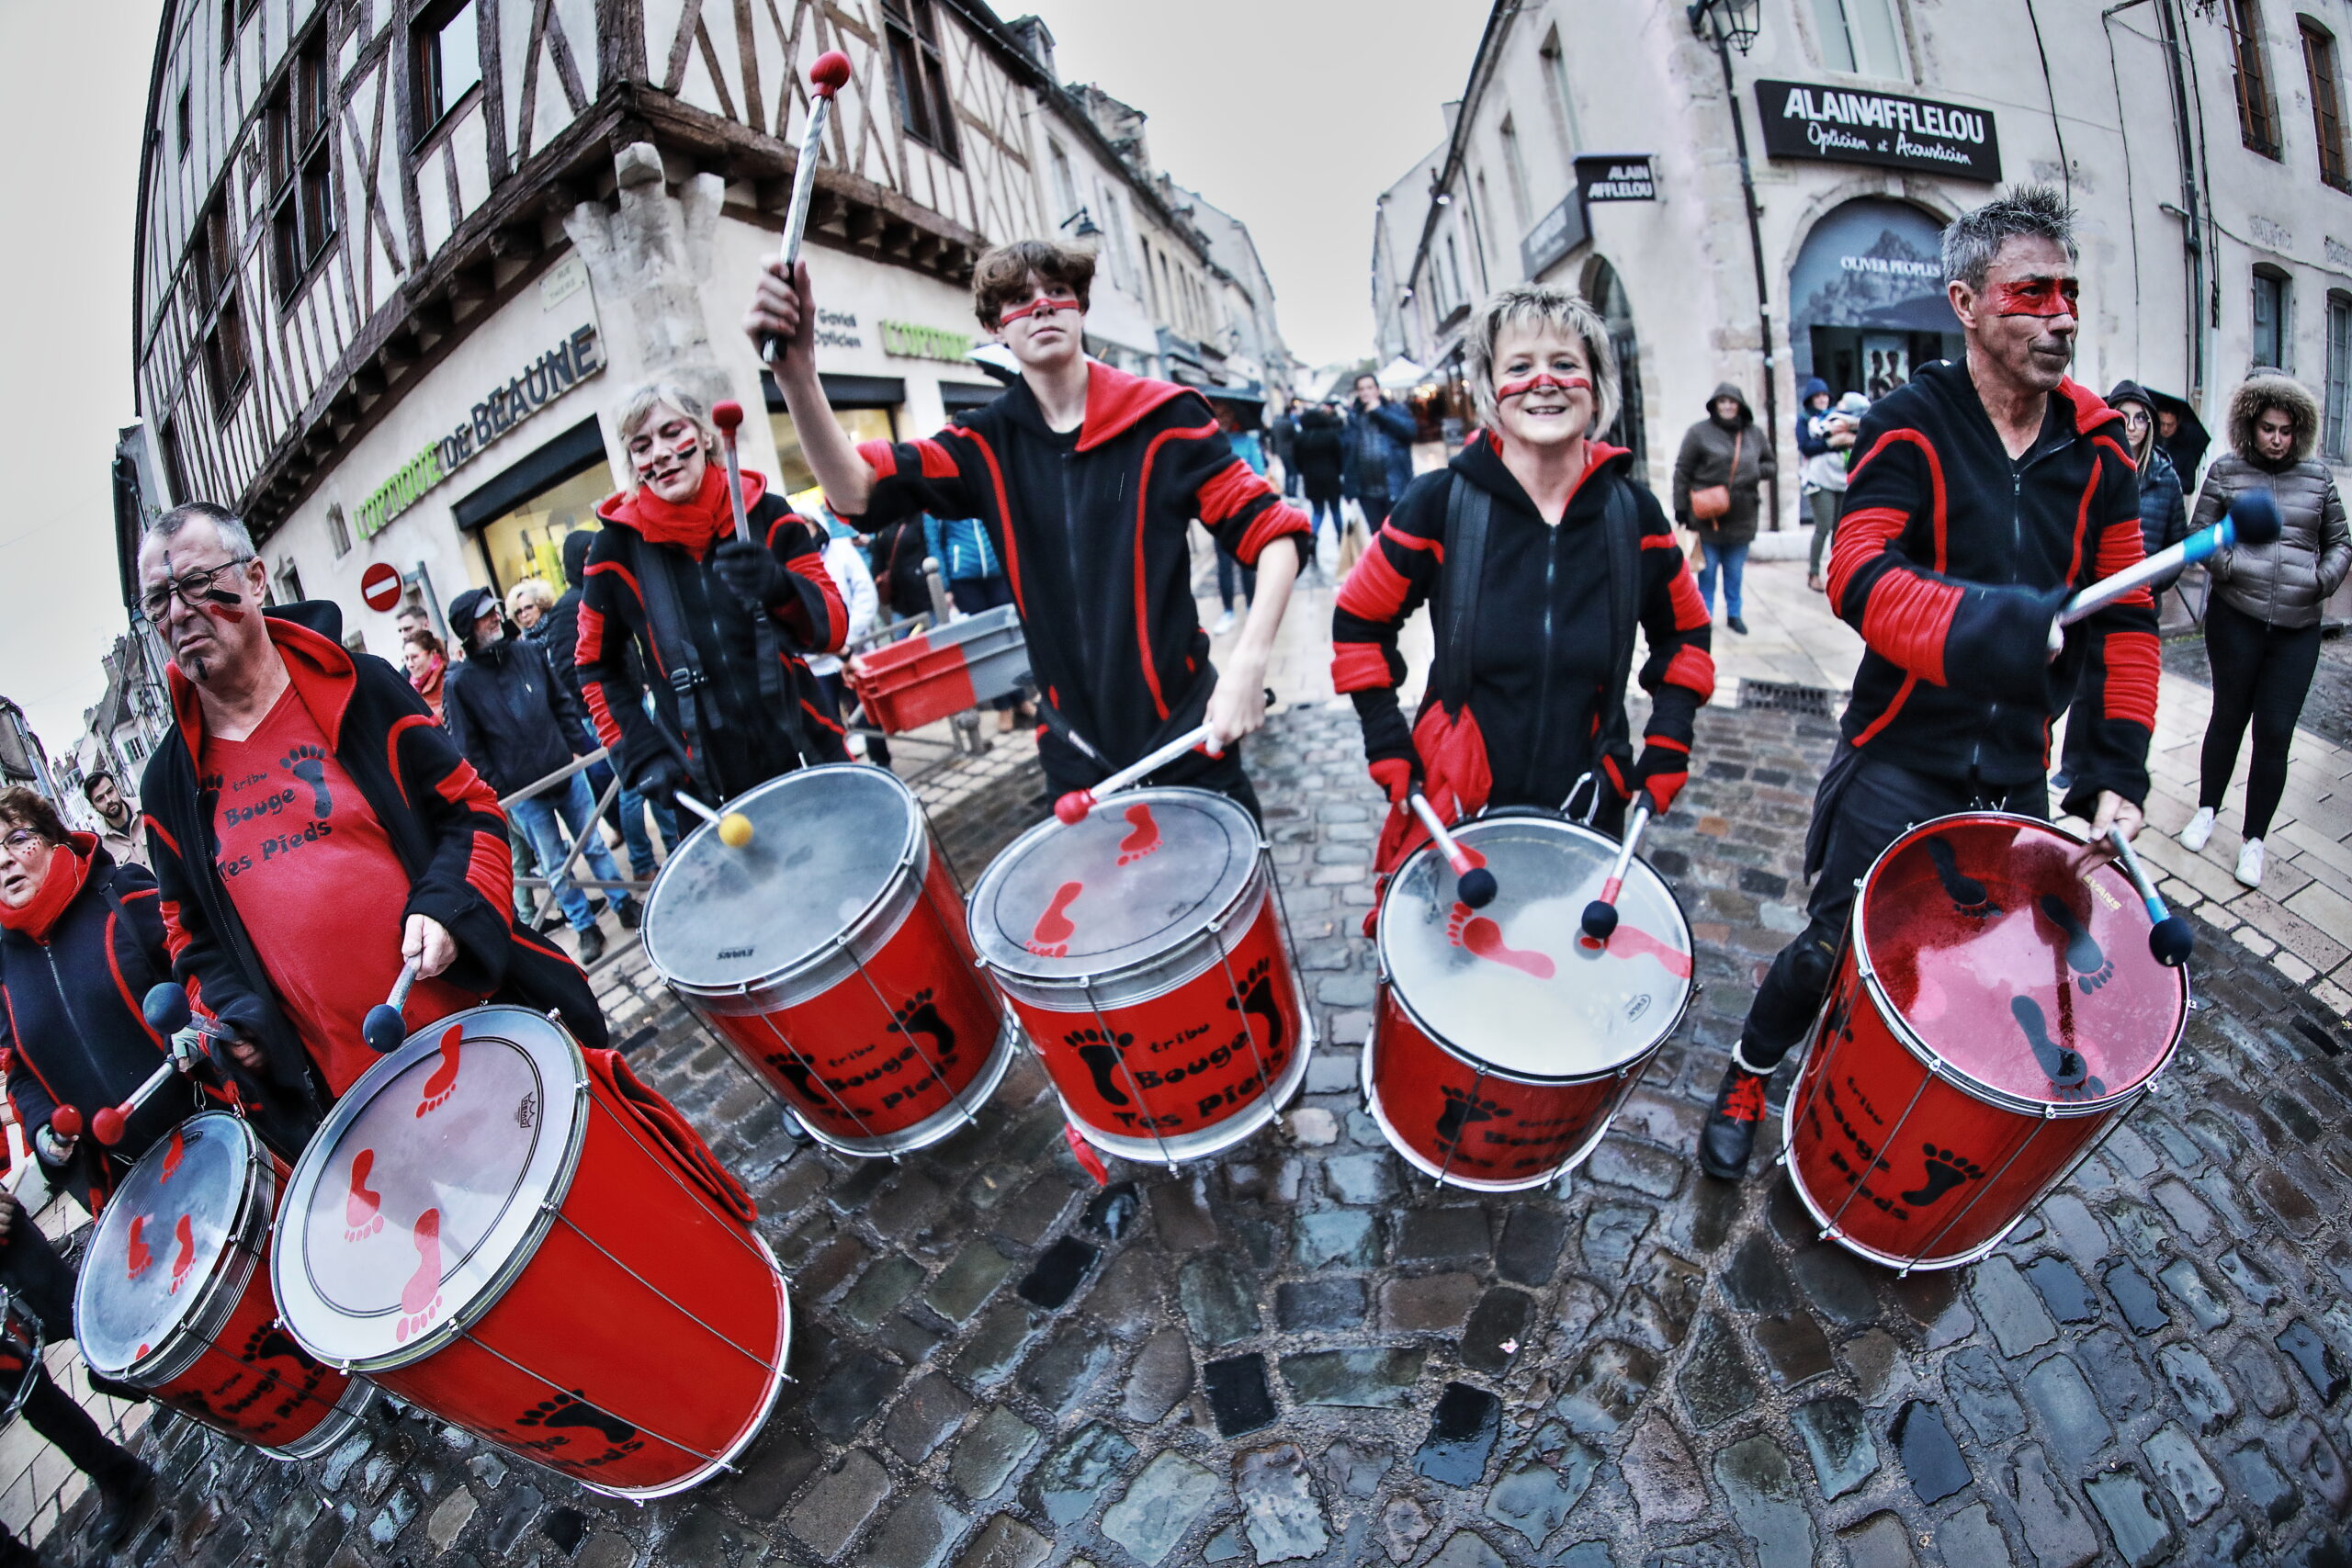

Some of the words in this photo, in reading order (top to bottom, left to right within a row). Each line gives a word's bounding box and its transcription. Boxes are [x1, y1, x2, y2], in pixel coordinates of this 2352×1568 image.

[1807, 120, 1870, 154] Opticien
[1895, 131, 1973, 165] Acousticien
[1588, 182, 1653, 198] AFFLELOU
[1608, 165, 1650, 180] ALAIN
[1840, 255, 1888, 273] OLIVER
[1890, 259, 1941, 277] PEOPLES
[354, 441, 442, 540] L'OPTIQUE
[439, 423, 472, 468] DE
[470, 323, 596, 447] BEAUNE
[223, 789, 296, 829] Bouge
[260, 821, 332, 862] Pieds
[1134, 1031, 1250, 1089] Bouge
[1112, 1111, 1182, 1129] Tes
[1198, 1049, 1283, 1118] Pieds
